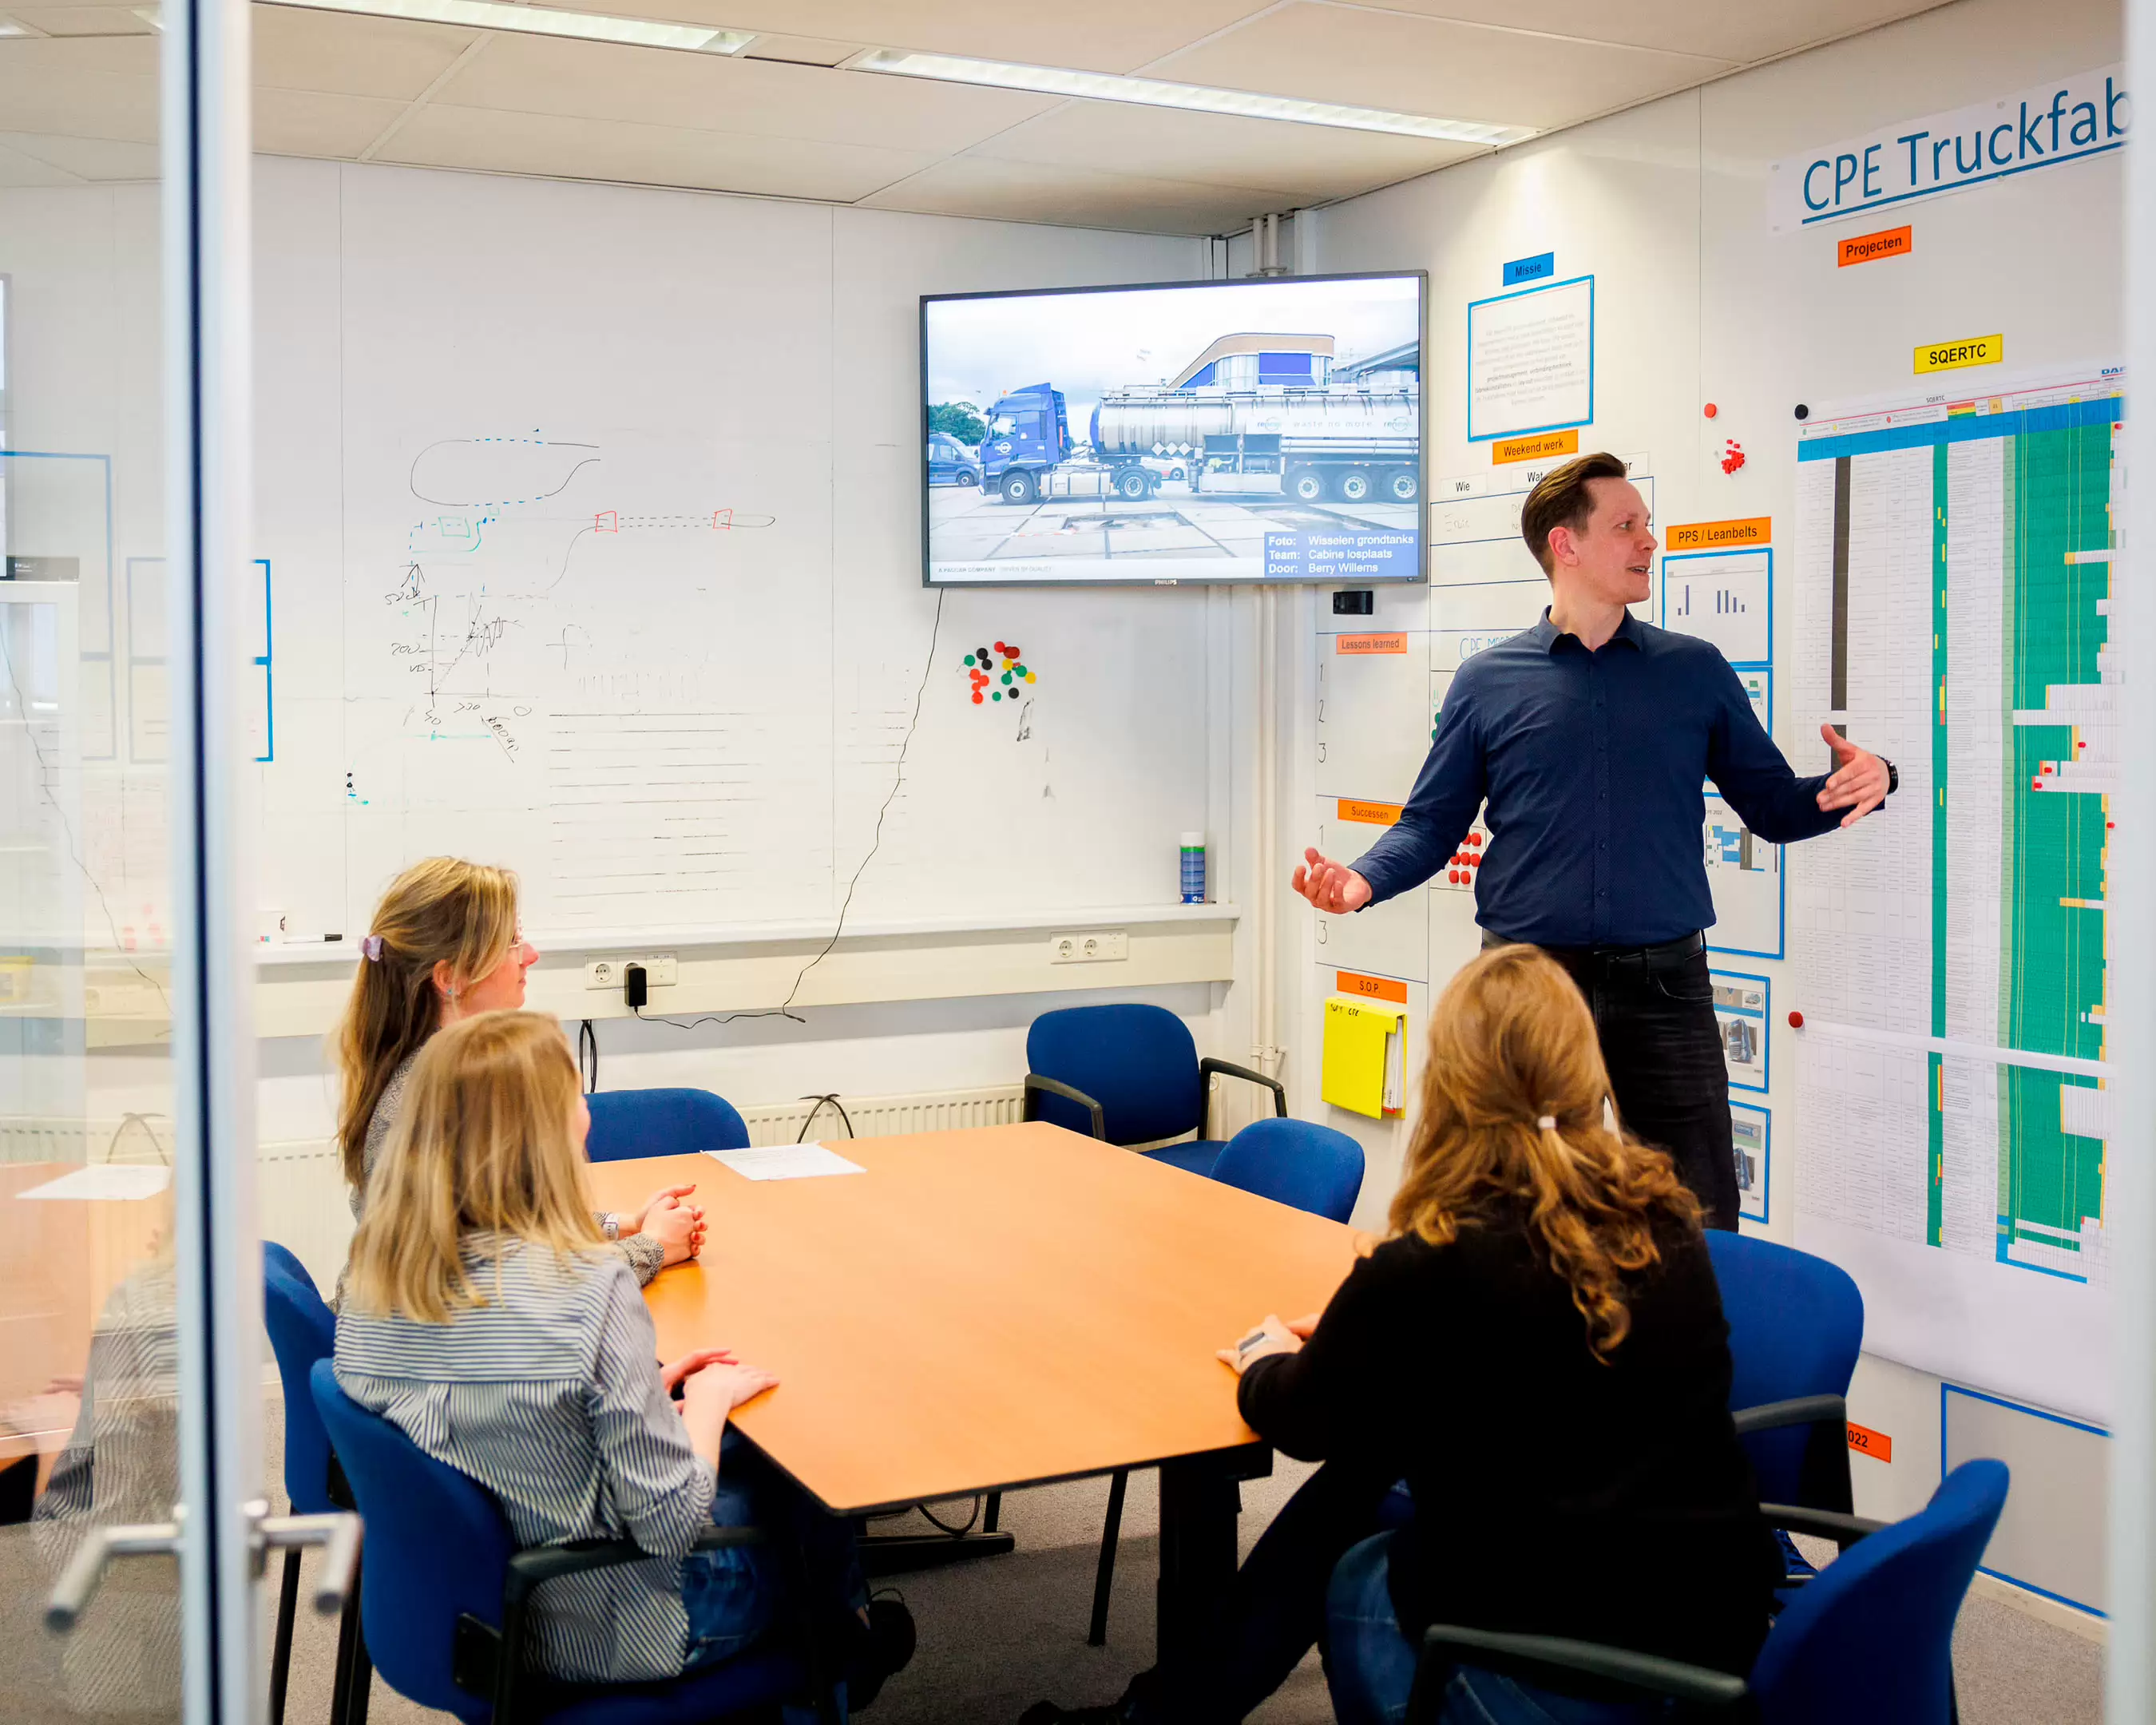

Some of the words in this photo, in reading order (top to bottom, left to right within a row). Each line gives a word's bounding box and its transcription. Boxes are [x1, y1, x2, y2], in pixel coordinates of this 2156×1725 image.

[1803, 144, 1882, 210] CPE
[1846, 237, 1902, 257] Projecten
[1515, 262, 1542, 277] Missie
[1929, 343, 1986, 365] SQERTC
[1504, 441, 1541, 457] Weekend
[1544, 438, 1563, 451] werk
[1528, 471, 1544, 483] Wat
[1456, 481, 1470, 492] Wie
[1268, 536, 1297, 546] Foto:
[1308, 536, 1356, 545] Wisselen
[1357, 534, 1414, 547] grondtanks
[1678, 530, 1698, 543] PPS
[1702, 529, 1705, 541] /
[1707, 525, 1758, 541] Leanbelts
[1268, 549, 1301, 560] Team:
[1308, 549, 1345, 559] Cabine
[1347, 549, 1393, 561] losplaats
[1268, 564, 1298, 573] Door:
[1308, 563, 1335, 575] Berry
[1338, 562, 1378, 573] Willems
[1342, 639, 1371, 649] Lessons
[1373, 638, 1400, 648] learned
[1318, 700, 1325, 723] 2
[1318, 743, 1327, 763] 3
[1351, 806, 1389, 820] Successen
[1319, 824, 1324, 845] 1
[1318, 919, 1328, 944] 3
[1359, 980, 1381, 993] S.O.P.
